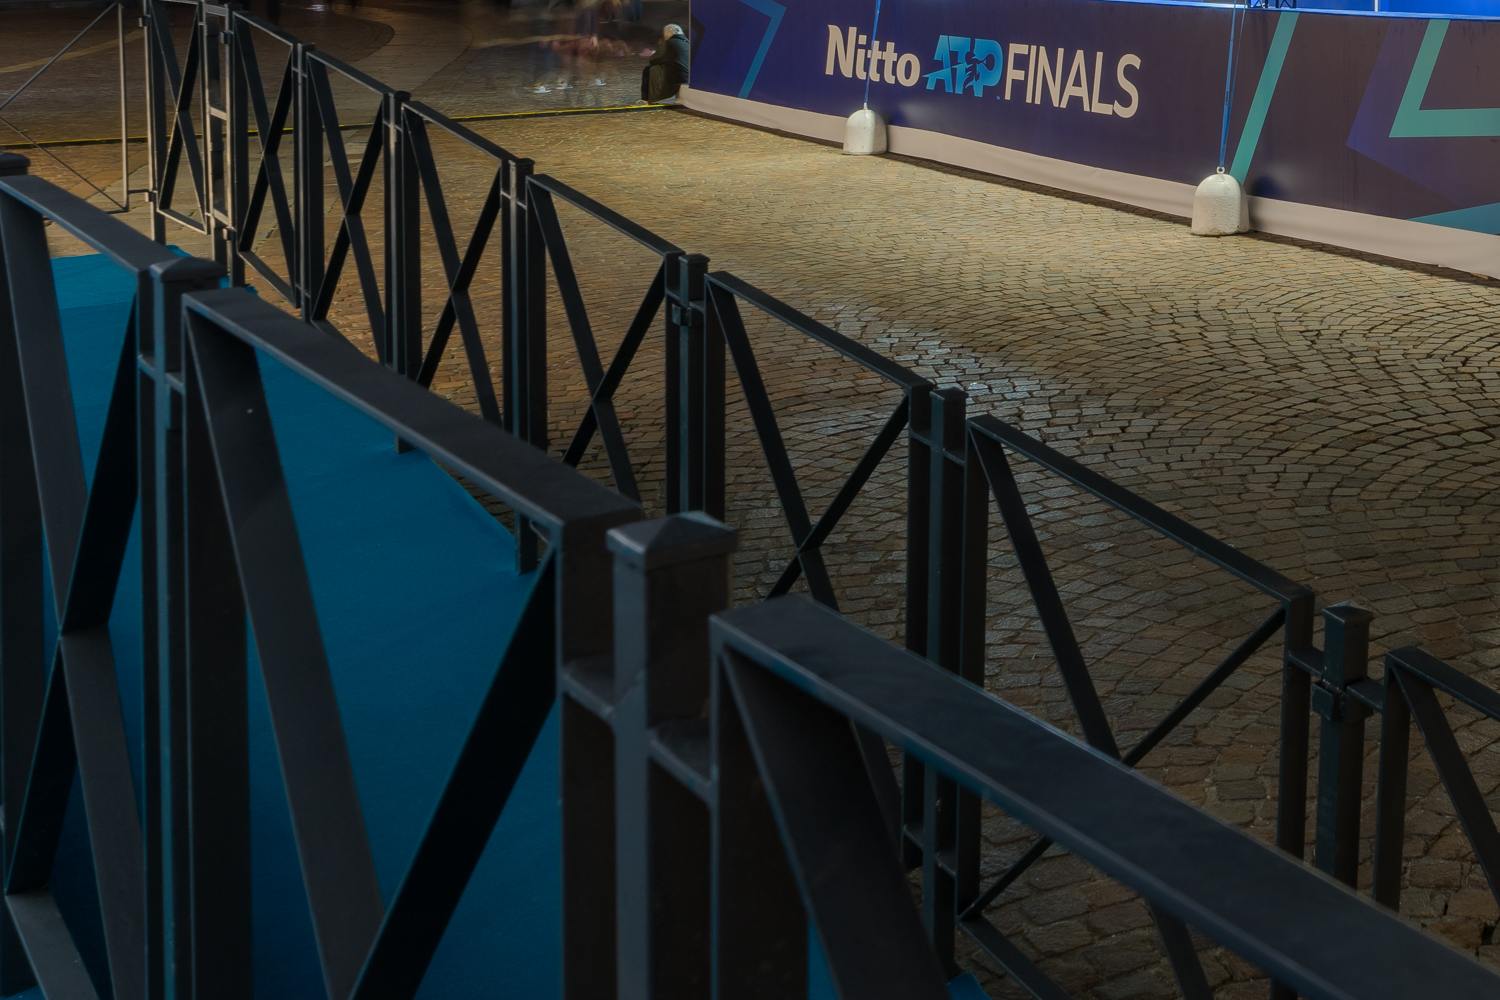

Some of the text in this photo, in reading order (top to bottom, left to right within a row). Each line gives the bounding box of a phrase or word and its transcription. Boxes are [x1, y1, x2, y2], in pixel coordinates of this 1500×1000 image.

[825, 24, 1142, 119] Nitto ATP FINALS
